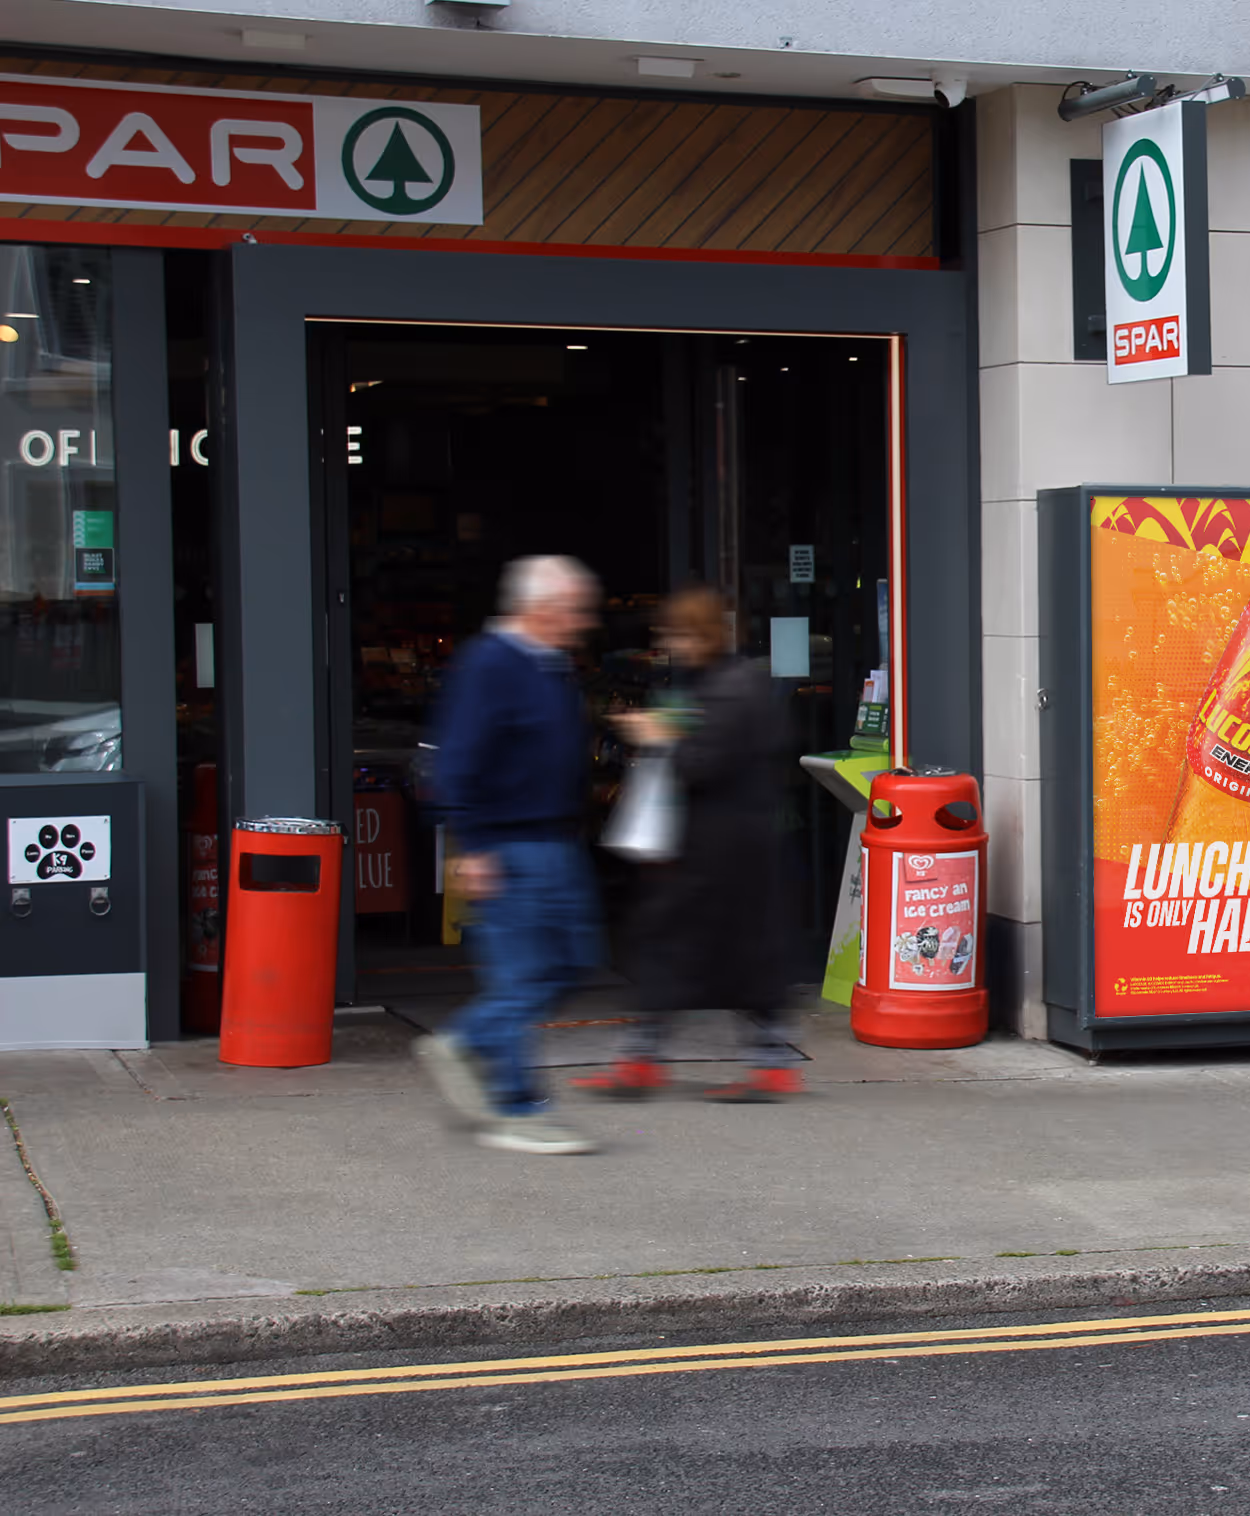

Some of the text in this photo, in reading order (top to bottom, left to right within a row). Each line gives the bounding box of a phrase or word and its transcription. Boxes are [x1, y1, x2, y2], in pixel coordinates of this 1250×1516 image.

[1115, 321, 1180, 358] SPAR
[20, 429, 96, 467] OF
[53, 852, 67, 866] K9
[904, 882, 968, 902] Fancy an
[929, 899, 970, 917] cream
[1123, 901, 1144, 928] IS
[1146, 899, 1194, 928] ONLY
